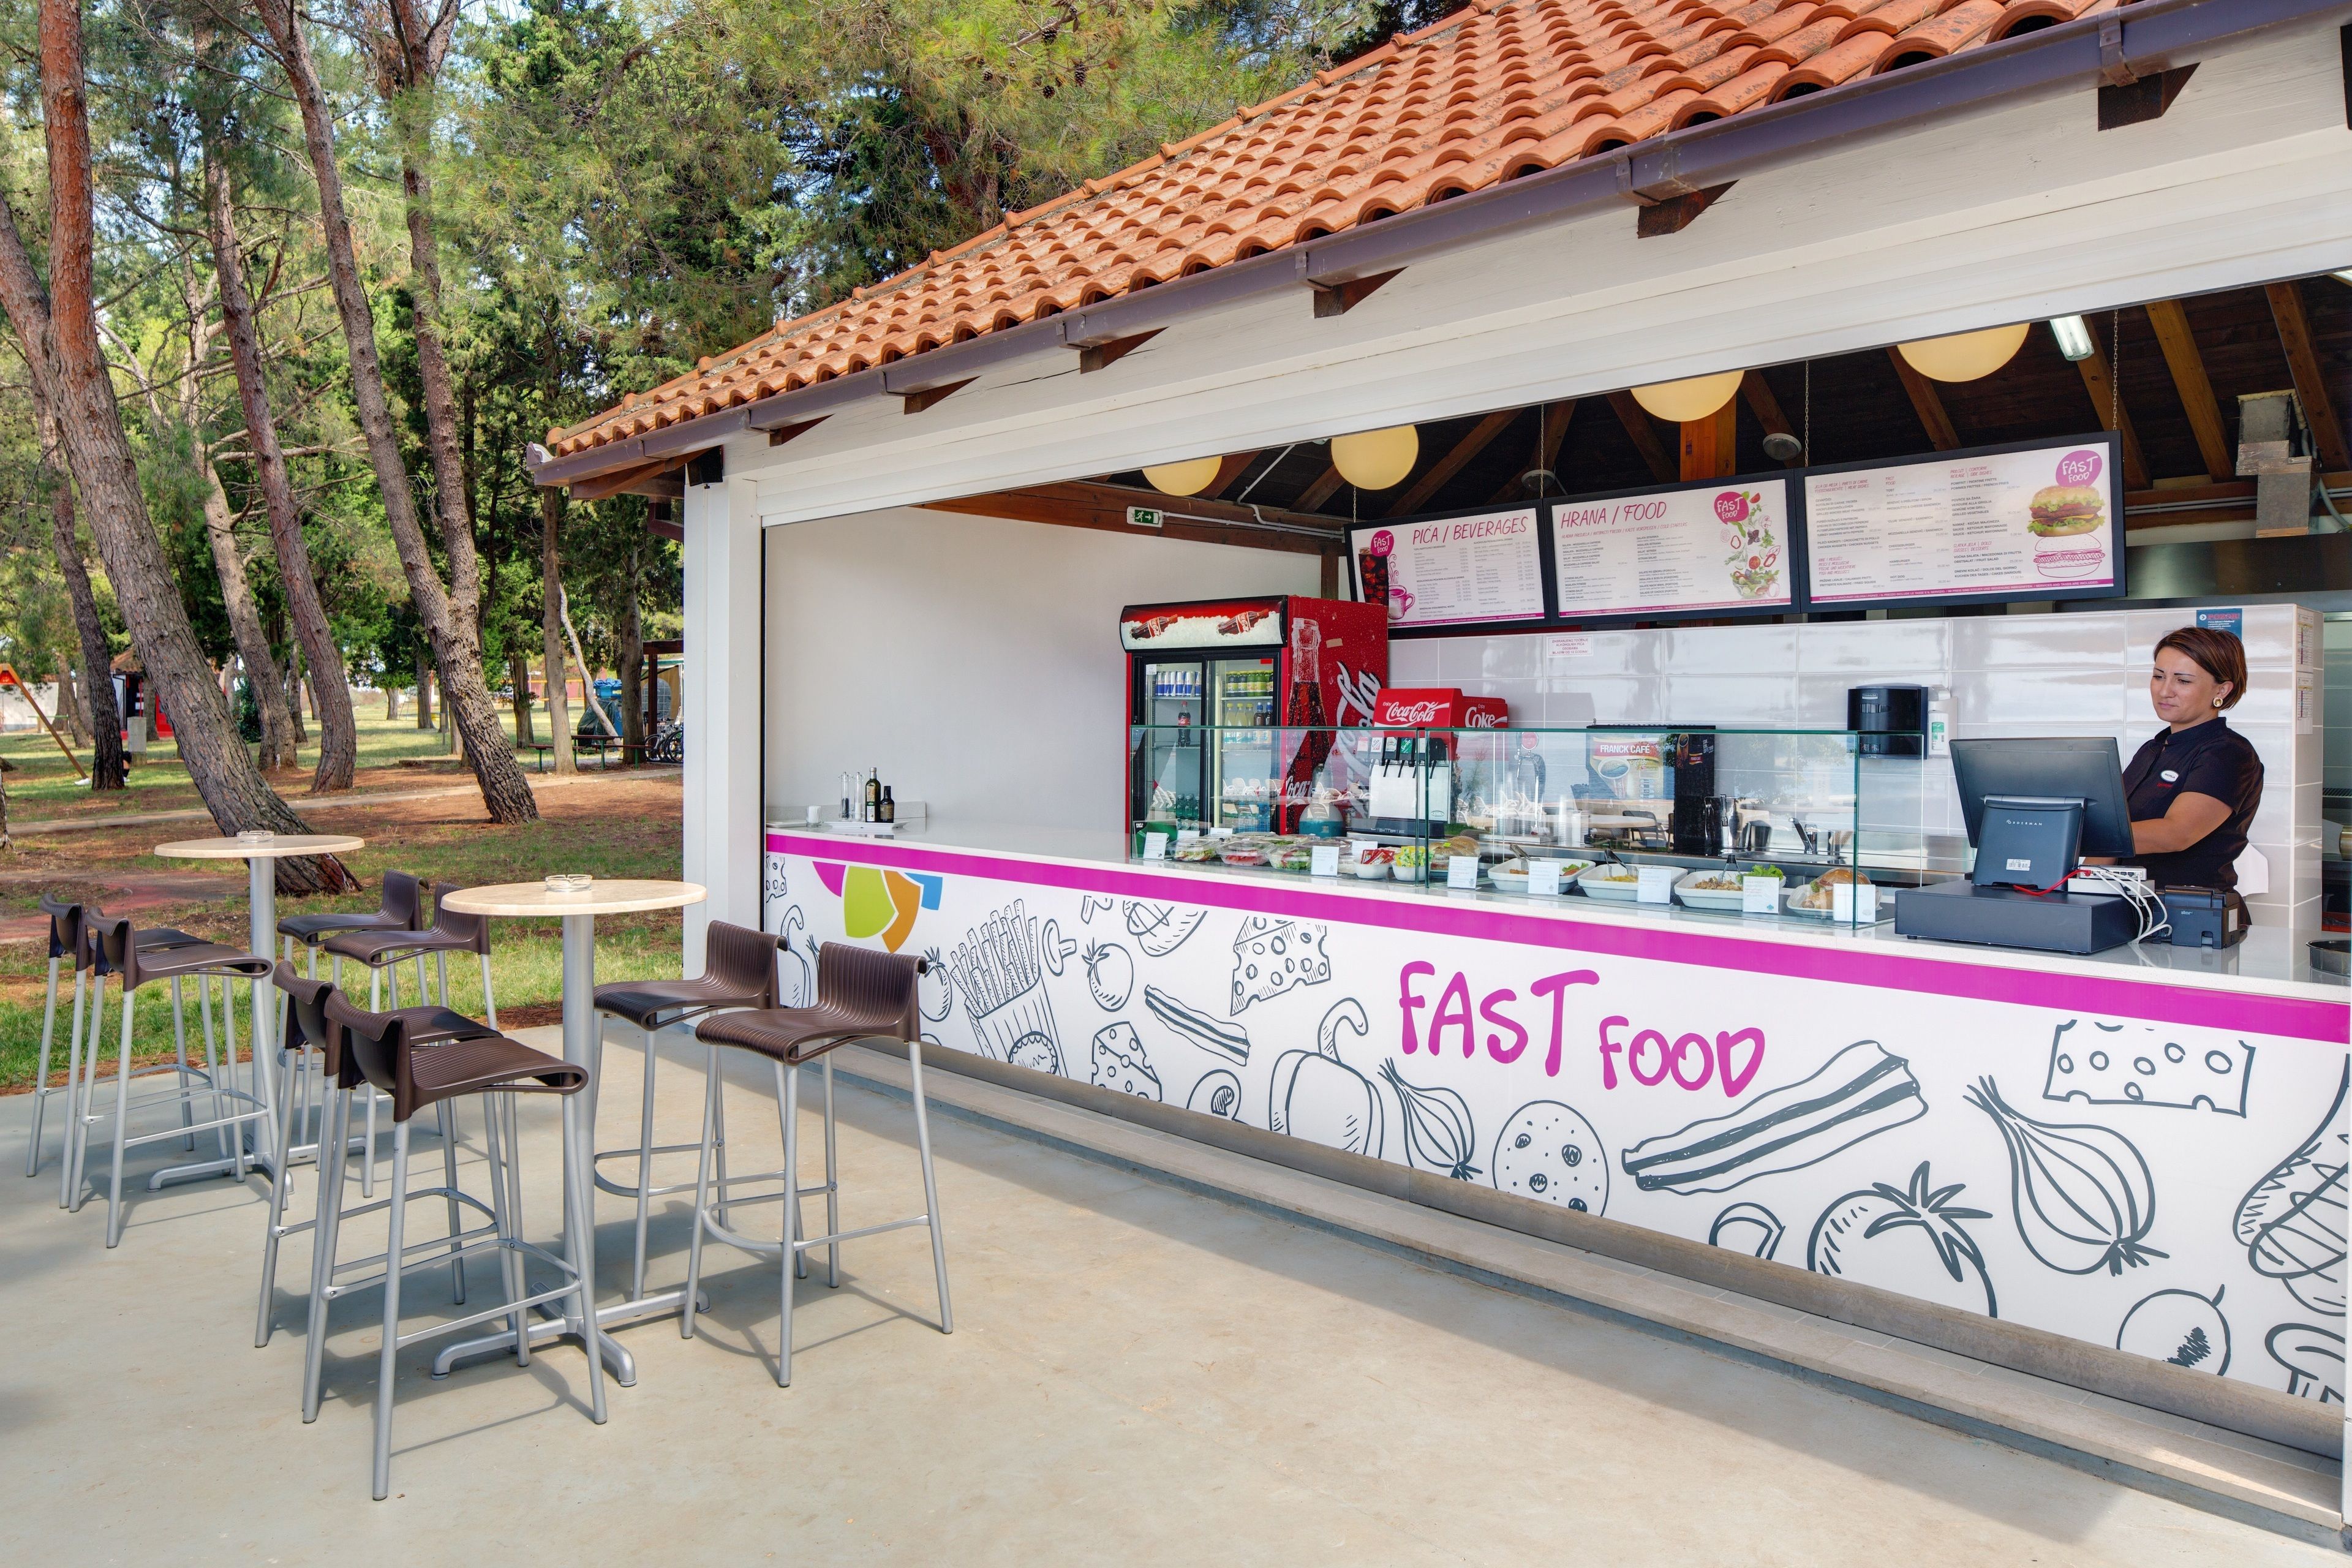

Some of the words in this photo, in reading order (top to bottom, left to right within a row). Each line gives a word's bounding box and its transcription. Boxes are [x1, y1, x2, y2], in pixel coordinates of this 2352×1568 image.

[2062, 456, 2098, 475] FAST
[2068, 472, 2089, 483] FOOD
[1717, 497, 1744, 513] FAST
[1722, 509, 1738, 519] FOOD
[1561, 508, 1607, 529] HRANA
[1612, 506, 1619, 525] /
[1624, 501, 1667, 522] FOOD
[1412, 525, 1438, 545] PIĆA
[1442, 526, 1450, 543] /
[1453, 516, 1529, 541] BEVERAGES
[1373, 533, 1393, 548] FAST
[1385, 701, 1449, 723] Coca-Cola
[1464, 706, 1497, 728] Coke
[1600, 745, 1629, 753] FRANCK
[1630, 744, 1650, 754] CAFÉ
[1399, 960, 1600, 1077] FAST
[1599, 1015, 1765, 1098] FOOD
